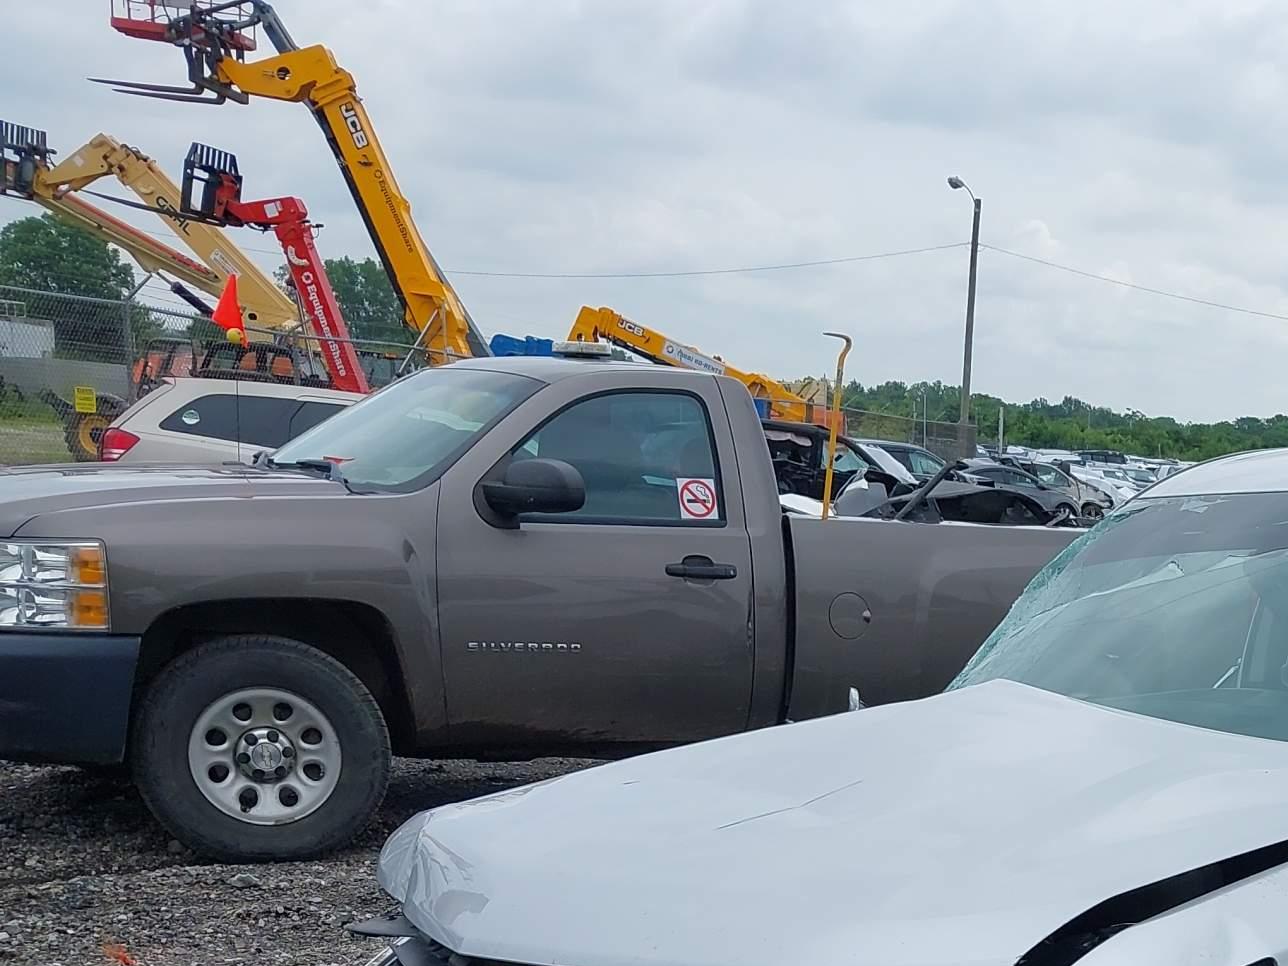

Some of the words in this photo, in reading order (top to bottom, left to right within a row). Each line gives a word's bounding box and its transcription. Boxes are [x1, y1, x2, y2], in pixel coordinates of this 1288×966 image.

[340, 103, 368, 149] JCB
[378, 179, 414, 254] EquipmentShare
[617, 319, 645, 337] JCB
[467, 641, 582, 652] SILVERADO
